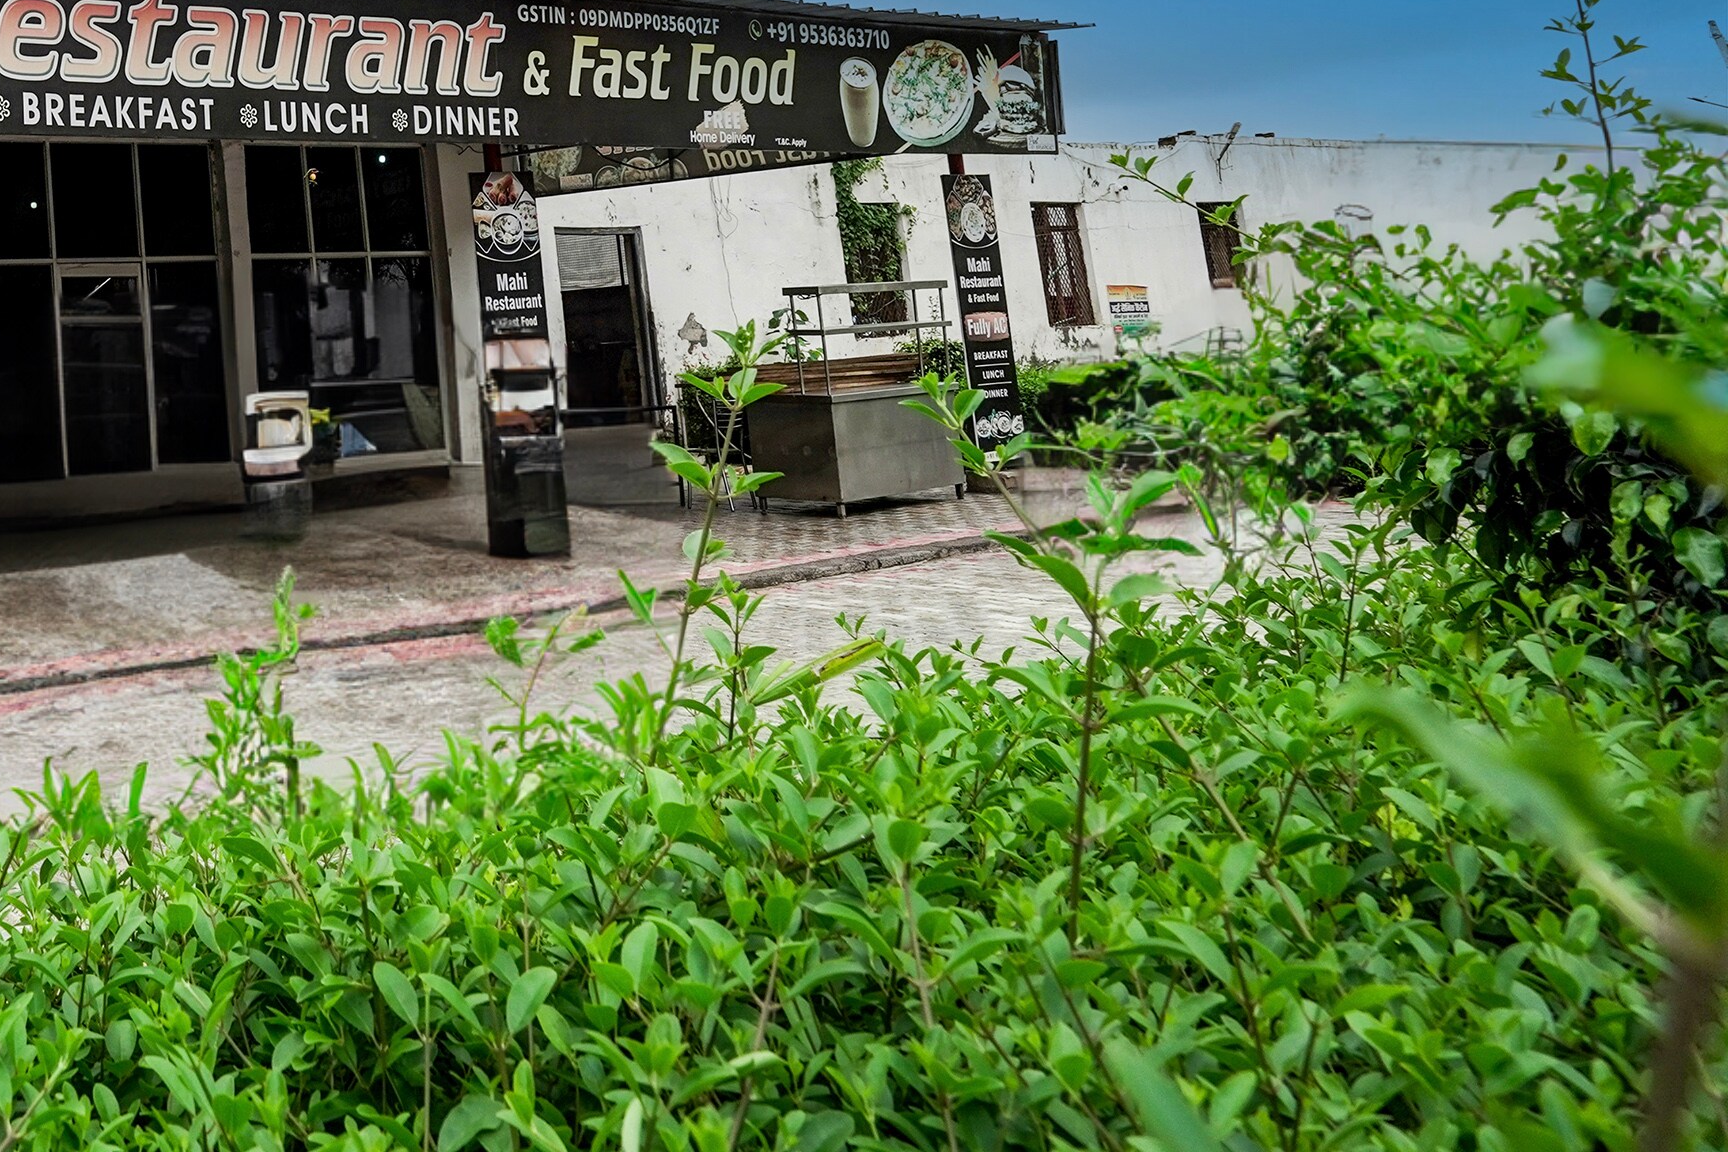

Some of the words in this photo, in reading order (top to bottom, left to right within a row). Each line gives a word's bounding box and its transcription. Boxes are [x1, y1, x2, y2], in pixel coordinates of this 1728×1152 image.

[517, 4, 566, 25] GSTIN
[766, 22, 795, 44] +91
[799, 23, 890, 50] 9536363710
[523, 50, 550, 96] &
[568, 35, 671, 100] Fast
[687, 42, 796, 106] Food
[22, 91, 214, 131] BREAKFAST
[264, 100, 369, 134] LUNCH
[413, 105, 520, 137] DINNER
[703, 110, 741, 129] FREE
[690, 129, 718, 144] Home
[719, 131, 756, 147] Delivery
[791, 138, 807, 147] Apply
[966, 257, 991, 273] Mahi
[496, 272, 528, 292] Mahi
[960, 275, 1003, 289] Restaurant
[485, 294, 543, 312] Restaurant
[967, 293, 973, 303] &
[973, 293, 986, 303] Fast
[986, 292, 1000, 303] Food
[520, 315, 538, 327] Food
[967, 318, 990, 338] Fully
[993, 317, 1007, 334] AC
[973, 350, 1008, 360] BREAKFAST
[982, 369, 1005, 379] LUNCH
[983, 389, 1009, 399] DINNER
